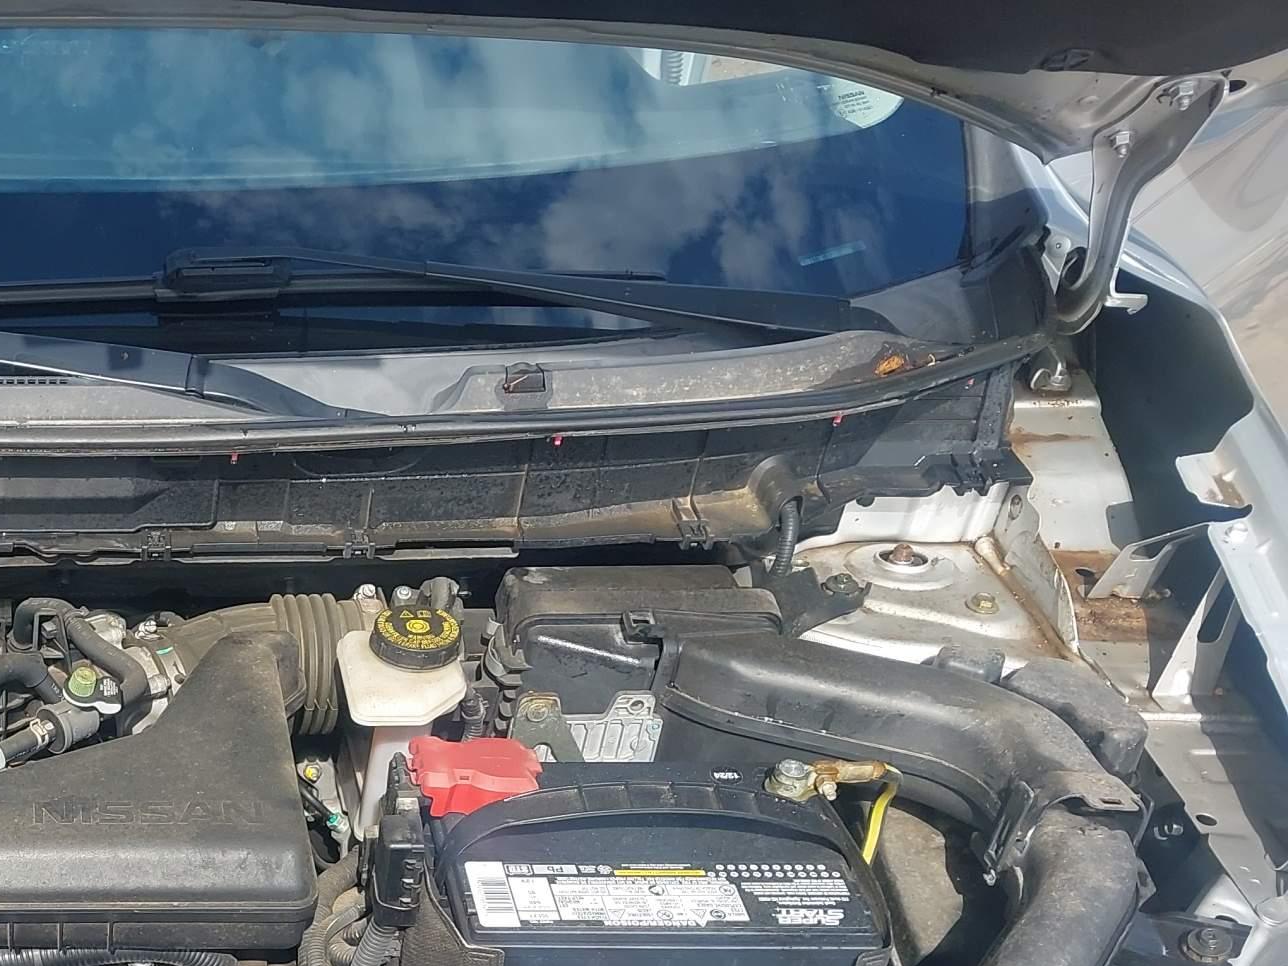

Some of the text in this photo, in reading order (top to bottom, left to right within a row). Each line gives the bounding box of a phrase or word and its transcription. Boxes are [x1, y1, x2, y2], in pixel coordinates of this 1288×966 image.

[32, 799, 265, 825] NISSAN
[776, 908, 845, 918] START
[603, 919, 698, 928] DANGER/POISON
[778, 917, 840, 926] SUPER
